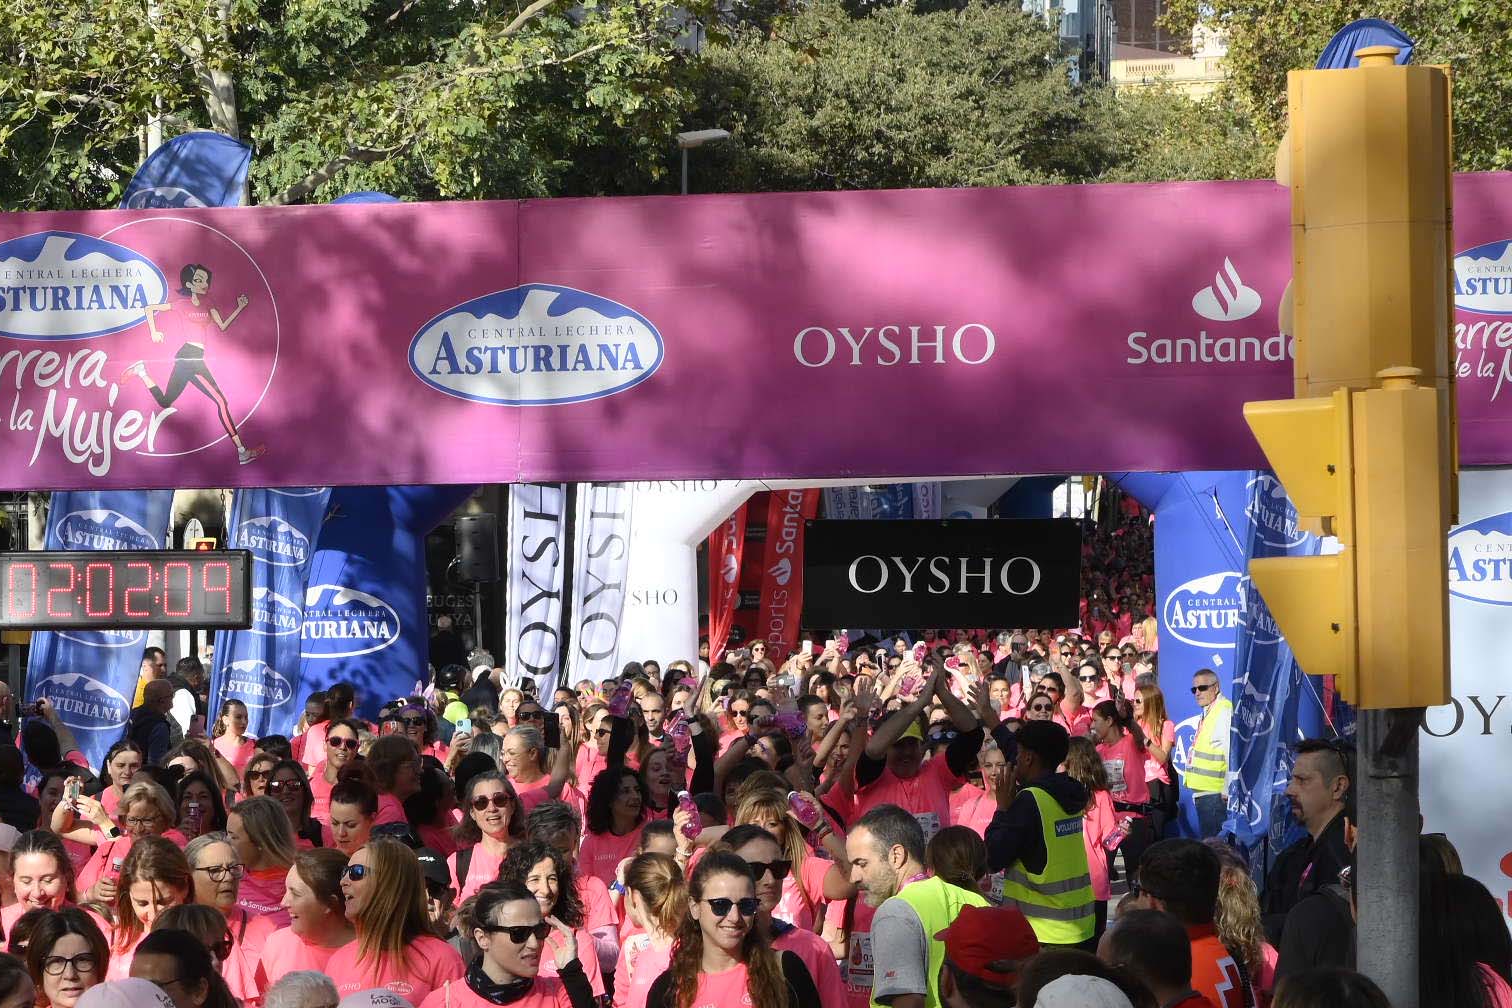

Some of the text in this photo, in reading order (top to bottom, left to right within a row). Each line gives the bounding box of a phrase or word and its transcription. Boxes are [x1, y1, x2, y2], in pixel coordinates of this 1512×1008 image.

[70, 267, 144, 280] LECHERA
[428, 330, 645, 376] ASTURIANA
[467, 324, 636, 341] CENTRAL LECHERA
[792, 322, 997, 368] OYSHO
[1126, 330, 1295, 364] Santand
[9, 395, 35, 431] la
[28, 383, 178, 478] Mujer
[775, 490, 804, 554] Santa
[7, 562, 232, 617] 02:02:09
[517, 483, 562, 675] OYSH
[578, 483, 626, 661] OYSH
[847, 554, 1042, 596] OYSHO
[632, 588, 679, 607] SHO
[1170, 600, 1239, 629] ASTUR
[1187, 599, 1237, 607] CENTRAL
[300, 620, 392, 640] TURIANA
